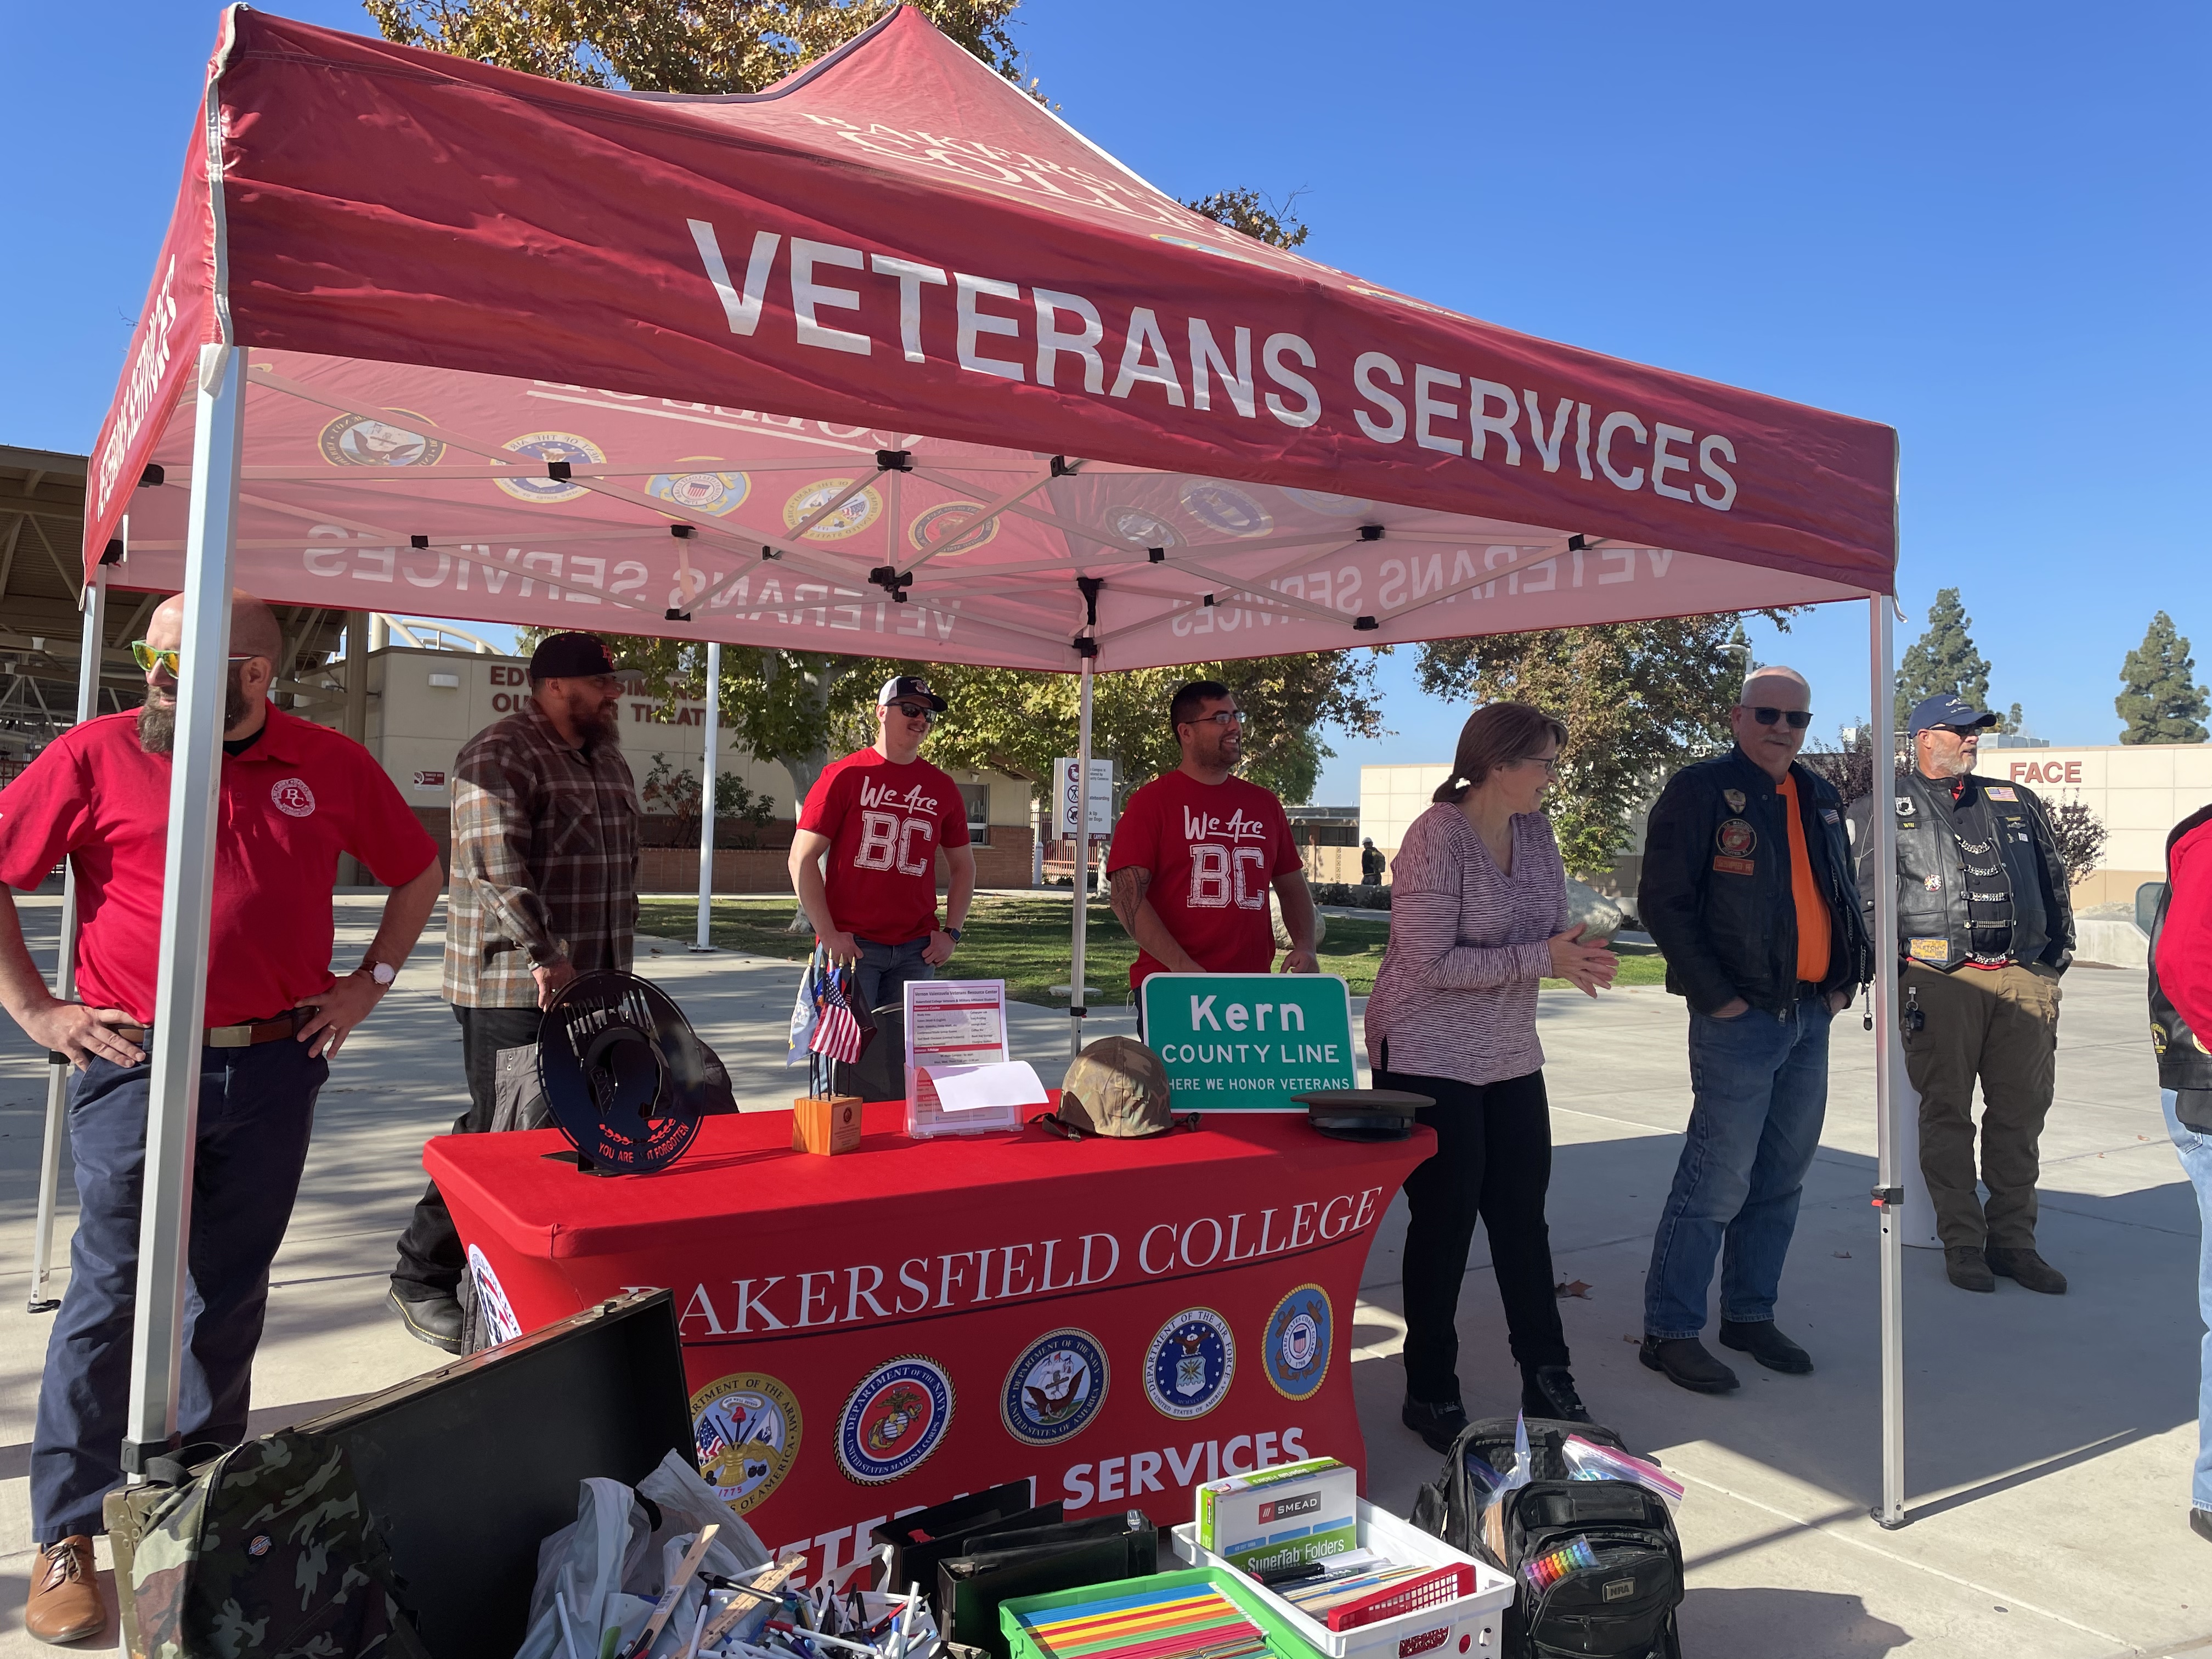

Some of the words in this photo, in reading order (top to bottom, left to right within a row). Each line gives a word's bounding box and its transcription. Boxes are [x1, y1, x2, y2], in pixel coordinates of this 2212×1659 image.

[686, 218, 1321, 428] VETERANS
[1353, 351, 1737, 512] SERVICES
[2010, 761, 2082, 783] FACE
[285, 788, 304, 807] BC
[860, 776, 896, 808] We
[904, 785, 937, 814] Are
[1184, 805, 1220, 840] We
[1226, 808, 1263, 843] Are
[854, 810, 933, 877] BC
[1187, 844, 1265, 910] BC
[1190, 994, 1305, 1032] Kern
[1162, 1044, 1272, 1063] COUNTY
[1281, 1044, 1340, 1063] LINE
[1169, 1078, 1200, 1091] HERE
[1205, 1078, 1225, 1091] WE
[1229, 1078, 1275, 1091] HONOR
[1279, 1077, 1350, 1091] VETERANS
[599, 1142, 615, 1159] YOU
[618, 1150, 634, 1163] ARE
[654, 1122, 690, 1159] FORGOTTEN
[679, 1232, 1120, 1338] AKERSFIELD
[1138, 1187, 1384, 1276] COLLEGE
[1285, 1317, 1301, 1336] STATES
[1301, 1316, 1314, 1330] COAST
[1013, 1341, 1059, 1391] DEPARTMENT
[1076, 1341, 1091, 1356] THE
[1088, 1353, 1100, 1374] NAVY
[1147, 1321, 1176, 1392] DEPARTMENT
[1181, 1312, 1193, 1322] OF
[1198, 1311, 1215, 1323] THE
[1215, 1322, 1228, 1339] AIR
[1223, 1342, 1233, 1379] FORCE
[1283, 1338, 1291, 1364] UNITED
[1295, 1359, 1306, 1368] 1790
[746, 1379, 761, 1388] OF
[764, 1382, 784, 1400] THE
[782, 1401, 797, 1433] ARMY
[847, 1367, 910, 1431] DEPARTMENT
[923, 1373, 935, 1384] THE
[933, 1382, 945, 1413] NAVY
[1009, 1401, 1028, 1431] UNITED
[1027, 1427, 1057, 1437] STATES
[1059, 1423, 1070, 1432] OF
[1073, 1387, 1099, 1425] AMERICA
[1154, 1396, 1171, 1414] UNITED
[1205, 1386, 1226, 1409] AMERICA
[847, 1438, 861, 1468] UNITED
[861, 1464, 889, 1474] STATES
[890, 1447, 923, 1471] MARINE
[922, 1421, 939, 1450] CORPS
[741, 1495, 755, 1509] OF
[758, 1443, 794, 1494] AMERICA
[1063, 1427, 1309, 1510] SERVICES
[718, 1486, 742, 1497] 1775
[1278, 1498, 1317, 1514] SMEAD
[1248, 1548, 1300, 1573] SuperTab
[1306, 1539, 1344, 1561] Folders
[1610, 1585, 1630, 1596] NRA
